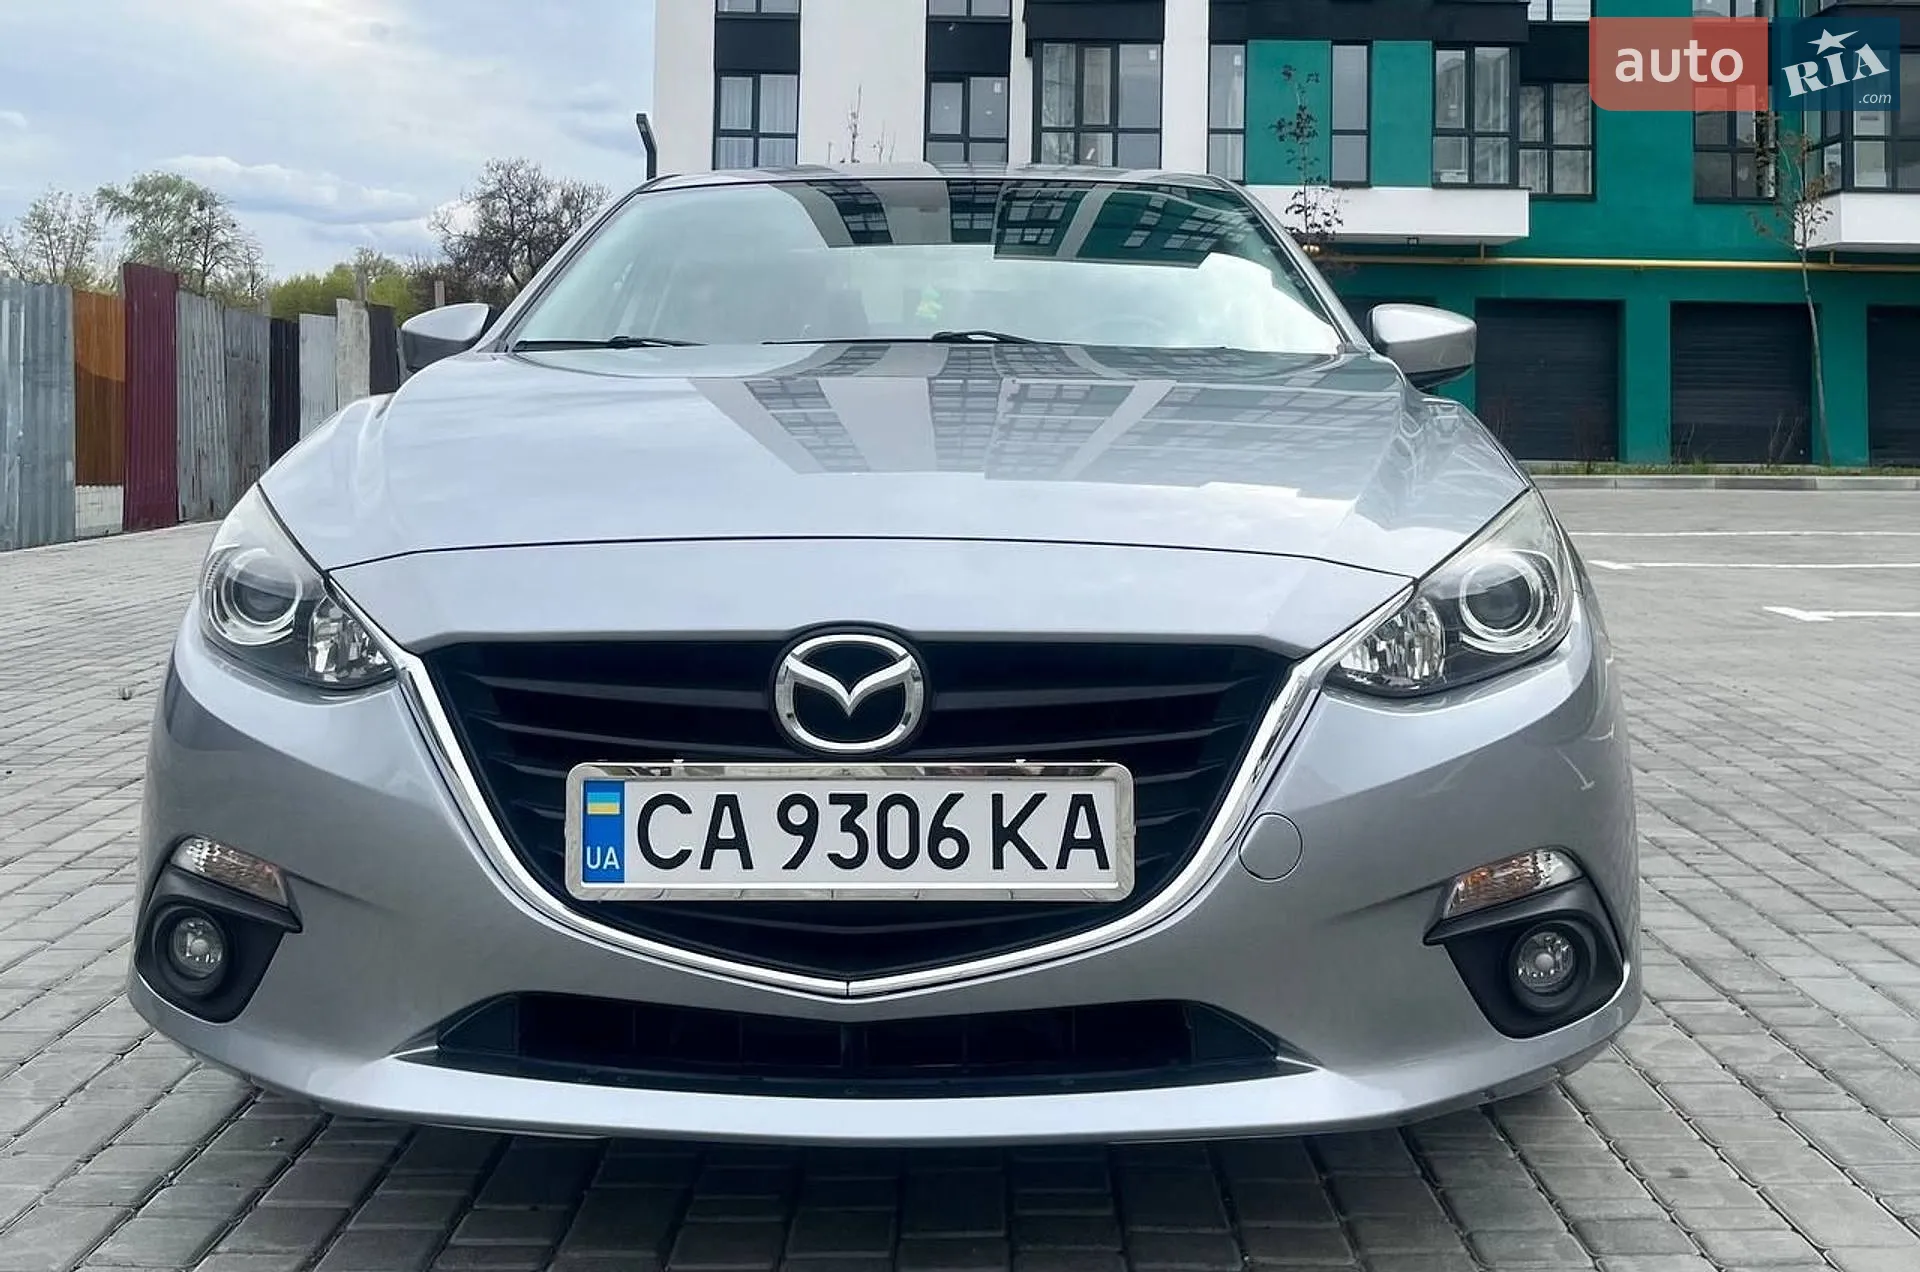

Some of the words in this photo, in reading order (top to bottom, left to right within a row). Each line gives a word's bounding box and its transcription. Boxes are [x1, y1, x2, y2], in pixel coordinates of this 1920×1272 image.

[636, 793, 754, 870] CA
[776, 792, 971, 871] 9306
[990, 793, 1110, 870] KA
[585, 847, 620, 870] UA
